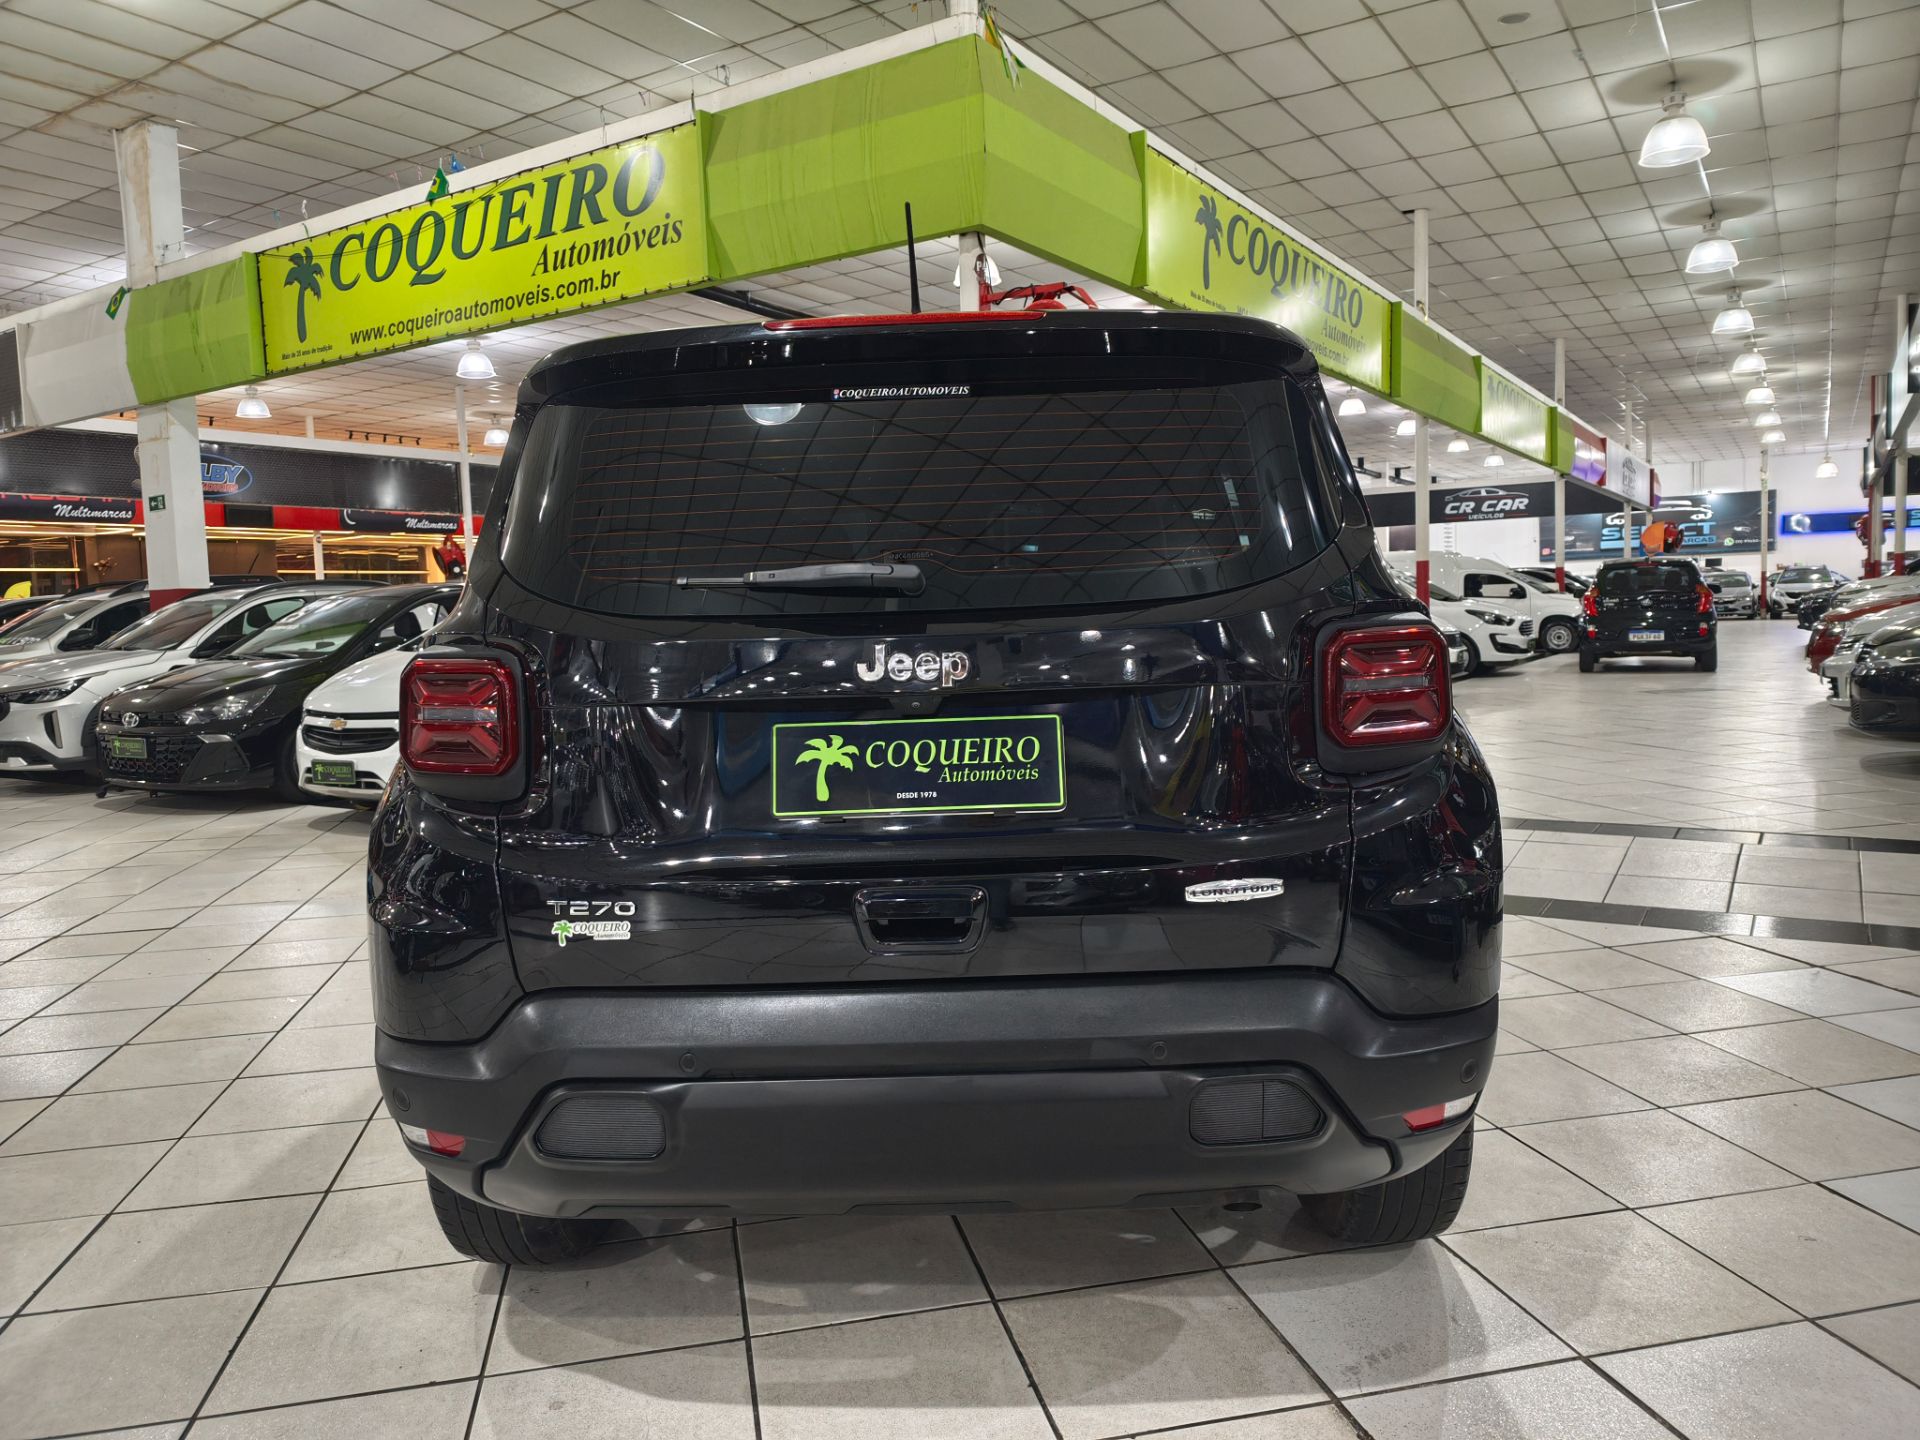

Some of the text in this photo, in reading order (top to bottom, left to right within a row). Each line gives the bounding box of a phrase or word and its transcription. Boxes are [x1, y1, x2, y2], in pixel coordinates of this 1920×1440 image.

[329, 147, 666, 291] COQUEIRO
[531, 213, 683, 277] Automóveis
[1227, 214, 1363, 328] COQUEIRO
[350, 269, 620, 345] www.coqueiroautomoveis.com.br
[839, 386, 970, 399] COQUEIROAUTOMOVEIS
[200, 463, 245, 484] LBY
[53, 504, 133, 519] Multimarcas
[1444, 498, 1529, 514] CR CAR
[405, 517, 458, 530] Multimarcas
[1602, 521, 1717, 541] SECT
[857, 644, 969, 686] Jeep
[865, 736, 1040, 773] COQUEIRO
[937, 765, 1039, 783] Automóveis
[546, 900, 636, 916] T270
[573, 922, 629, 936] COQUEIRO
